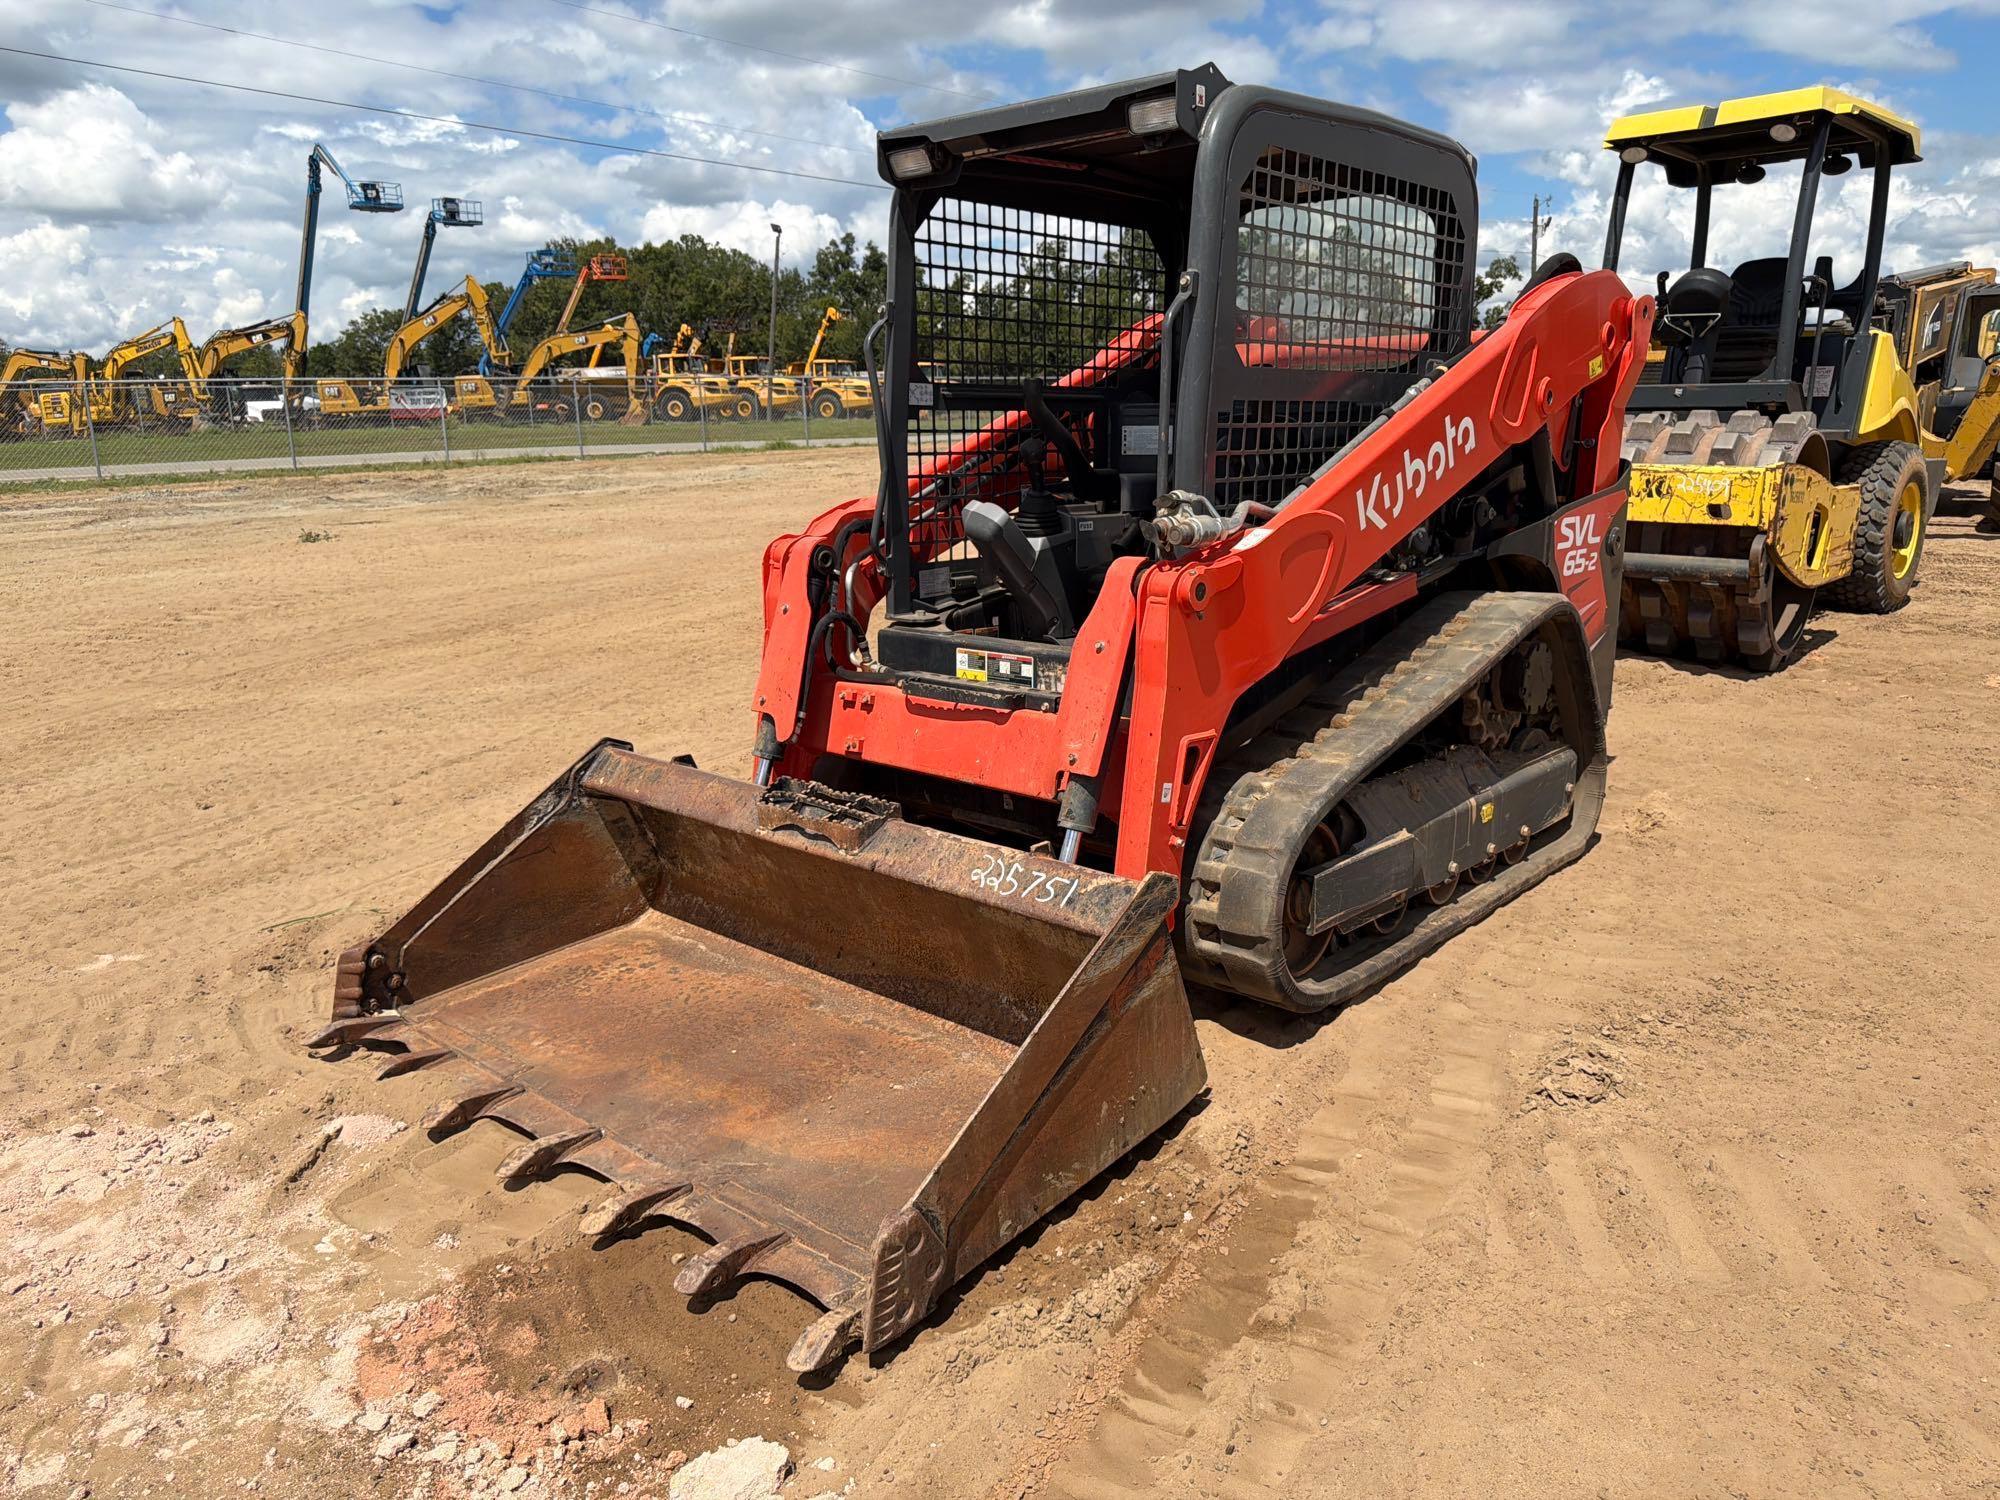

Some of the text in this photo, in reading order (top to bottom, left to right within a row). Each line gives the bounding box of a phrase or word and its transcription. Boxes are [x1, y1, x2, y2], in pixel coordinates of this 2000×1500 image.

[575, 335, 587, 344] CAT
[324, 386, 339, 397] CAT
[1355, 415, 1476, 531] Kubota
[1557, 515, 1601, 550] SVL
[971, 854, 1079, 908] 225751
